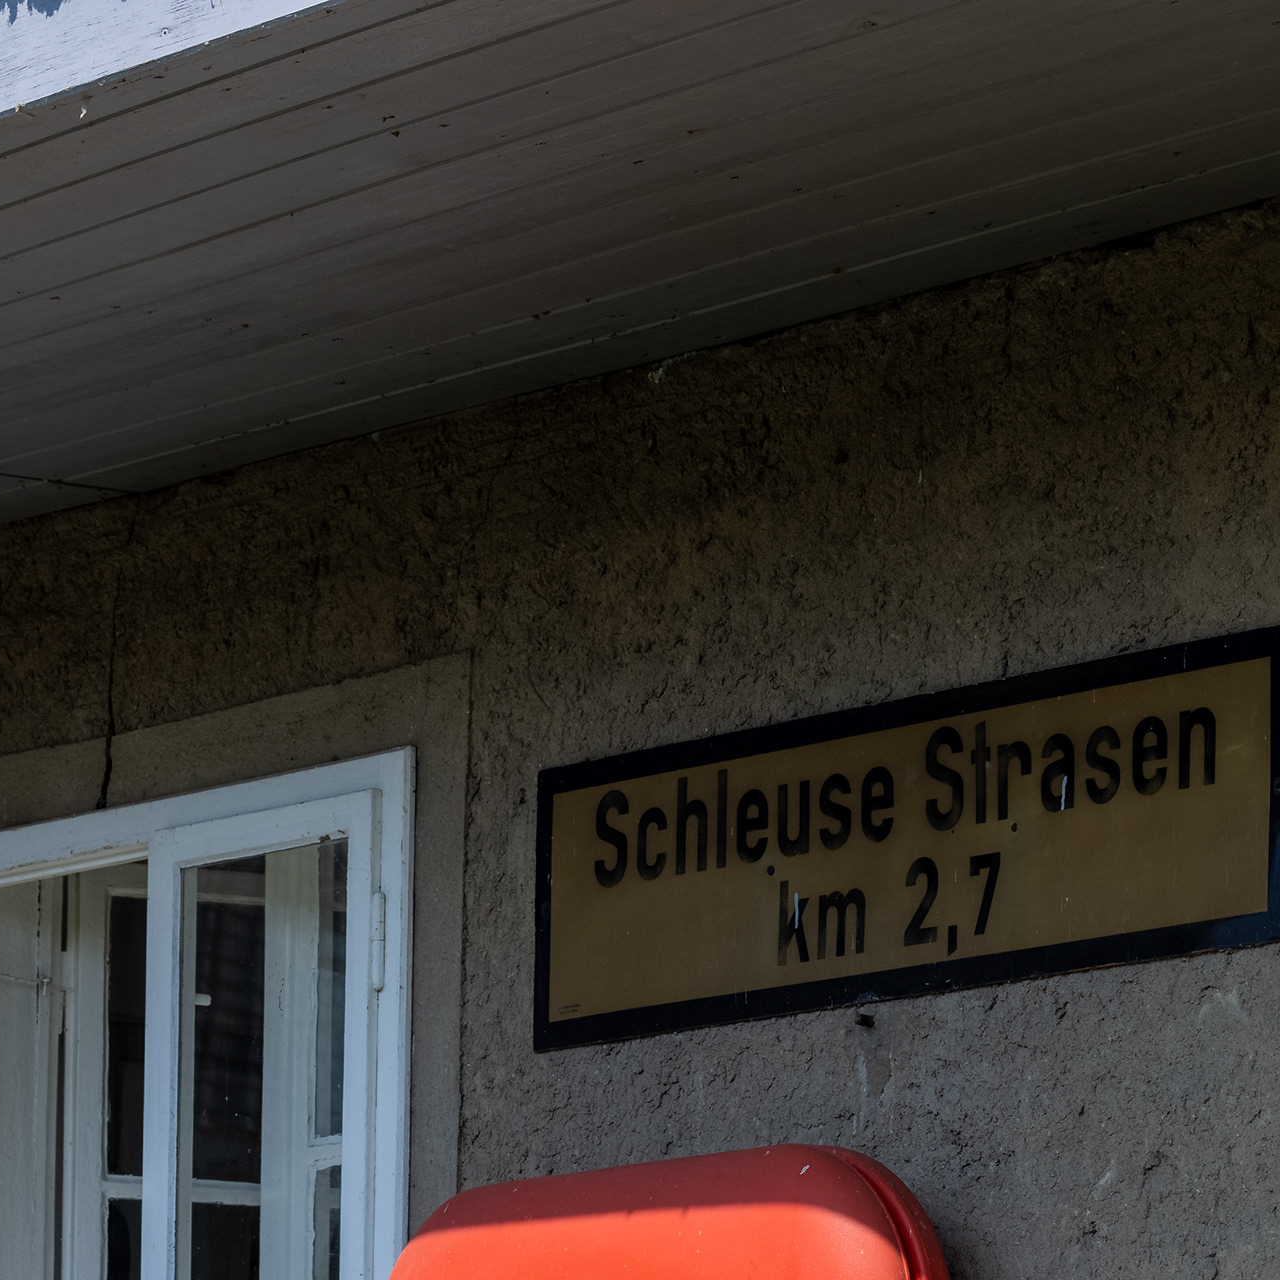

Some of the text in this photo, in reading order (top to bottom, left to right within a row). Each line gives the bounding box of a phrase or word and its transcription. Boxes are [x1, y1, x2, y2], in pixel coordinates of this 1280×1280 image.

[593, 704, 1218, 888] Schleuse Strasen
[776, 850, 1002, 967] km 2,7
